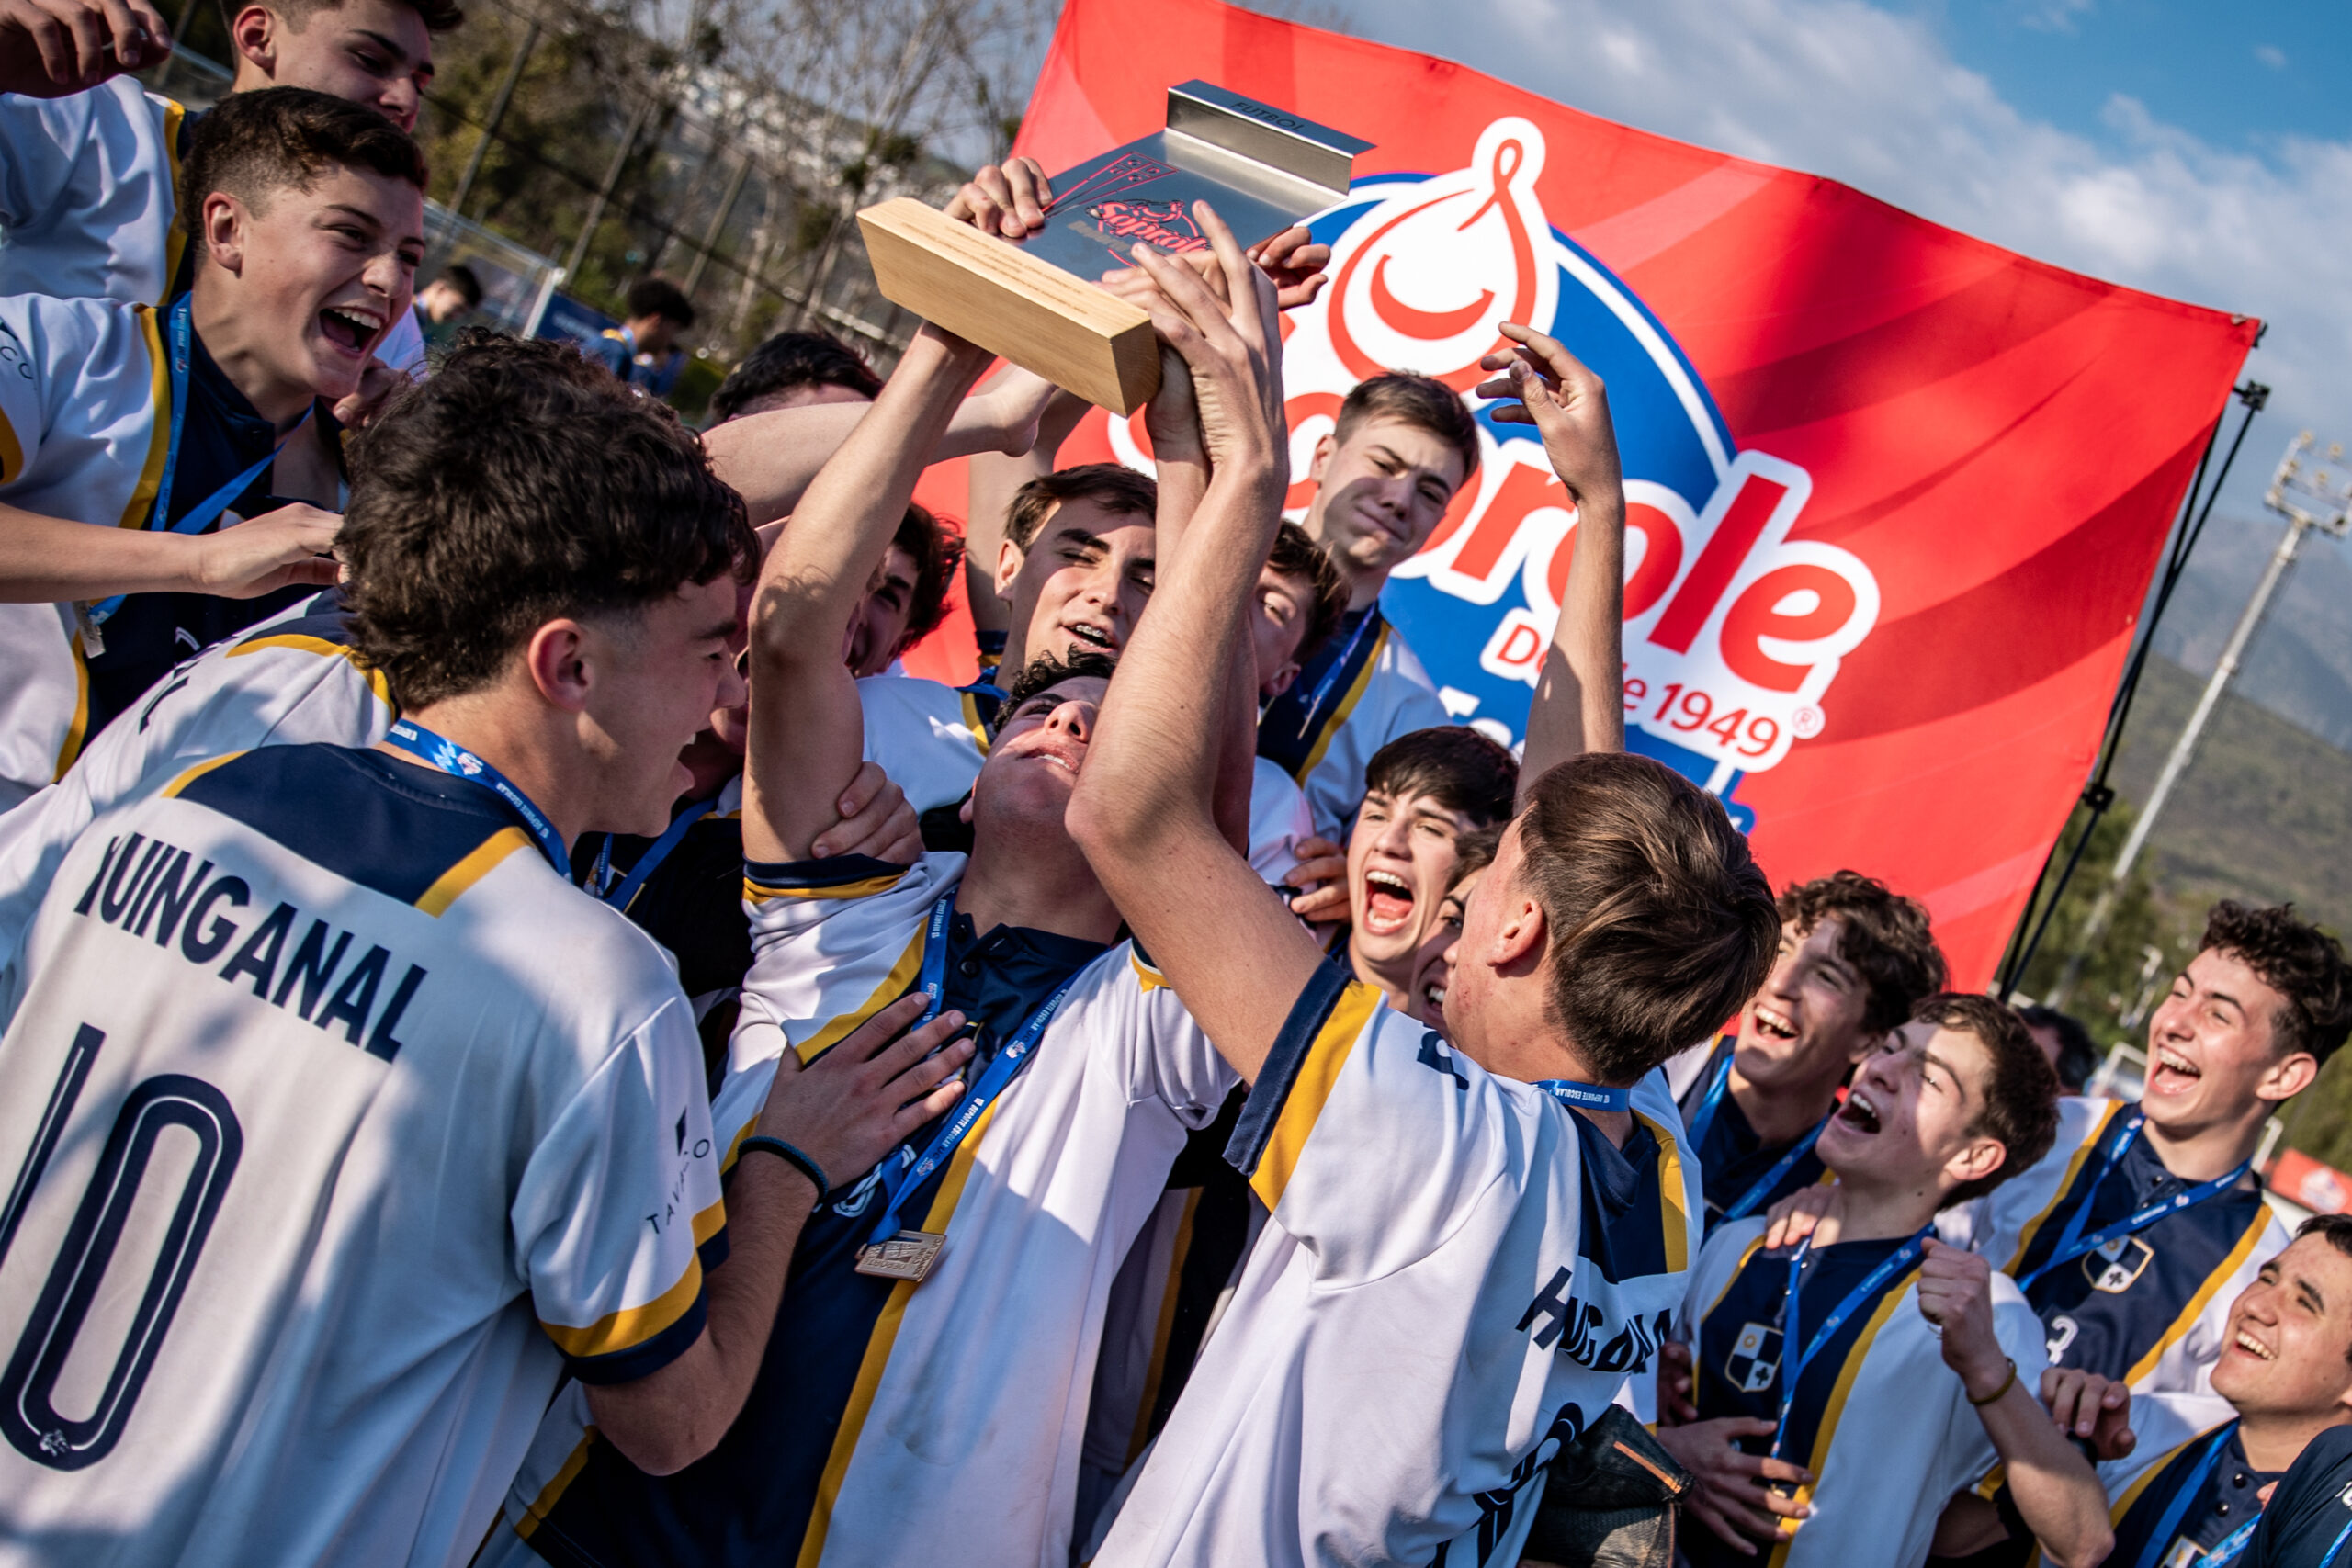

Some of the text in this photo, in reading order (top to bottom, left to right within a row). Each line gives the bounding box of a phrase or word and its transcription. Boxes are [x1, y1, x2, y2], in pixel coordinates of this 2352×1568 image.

[1232, 101, 1305, 133] FUTBOL
[1098, 201, 1213, 254] Soprol
[1654, 683, 1780, 757] 1949
